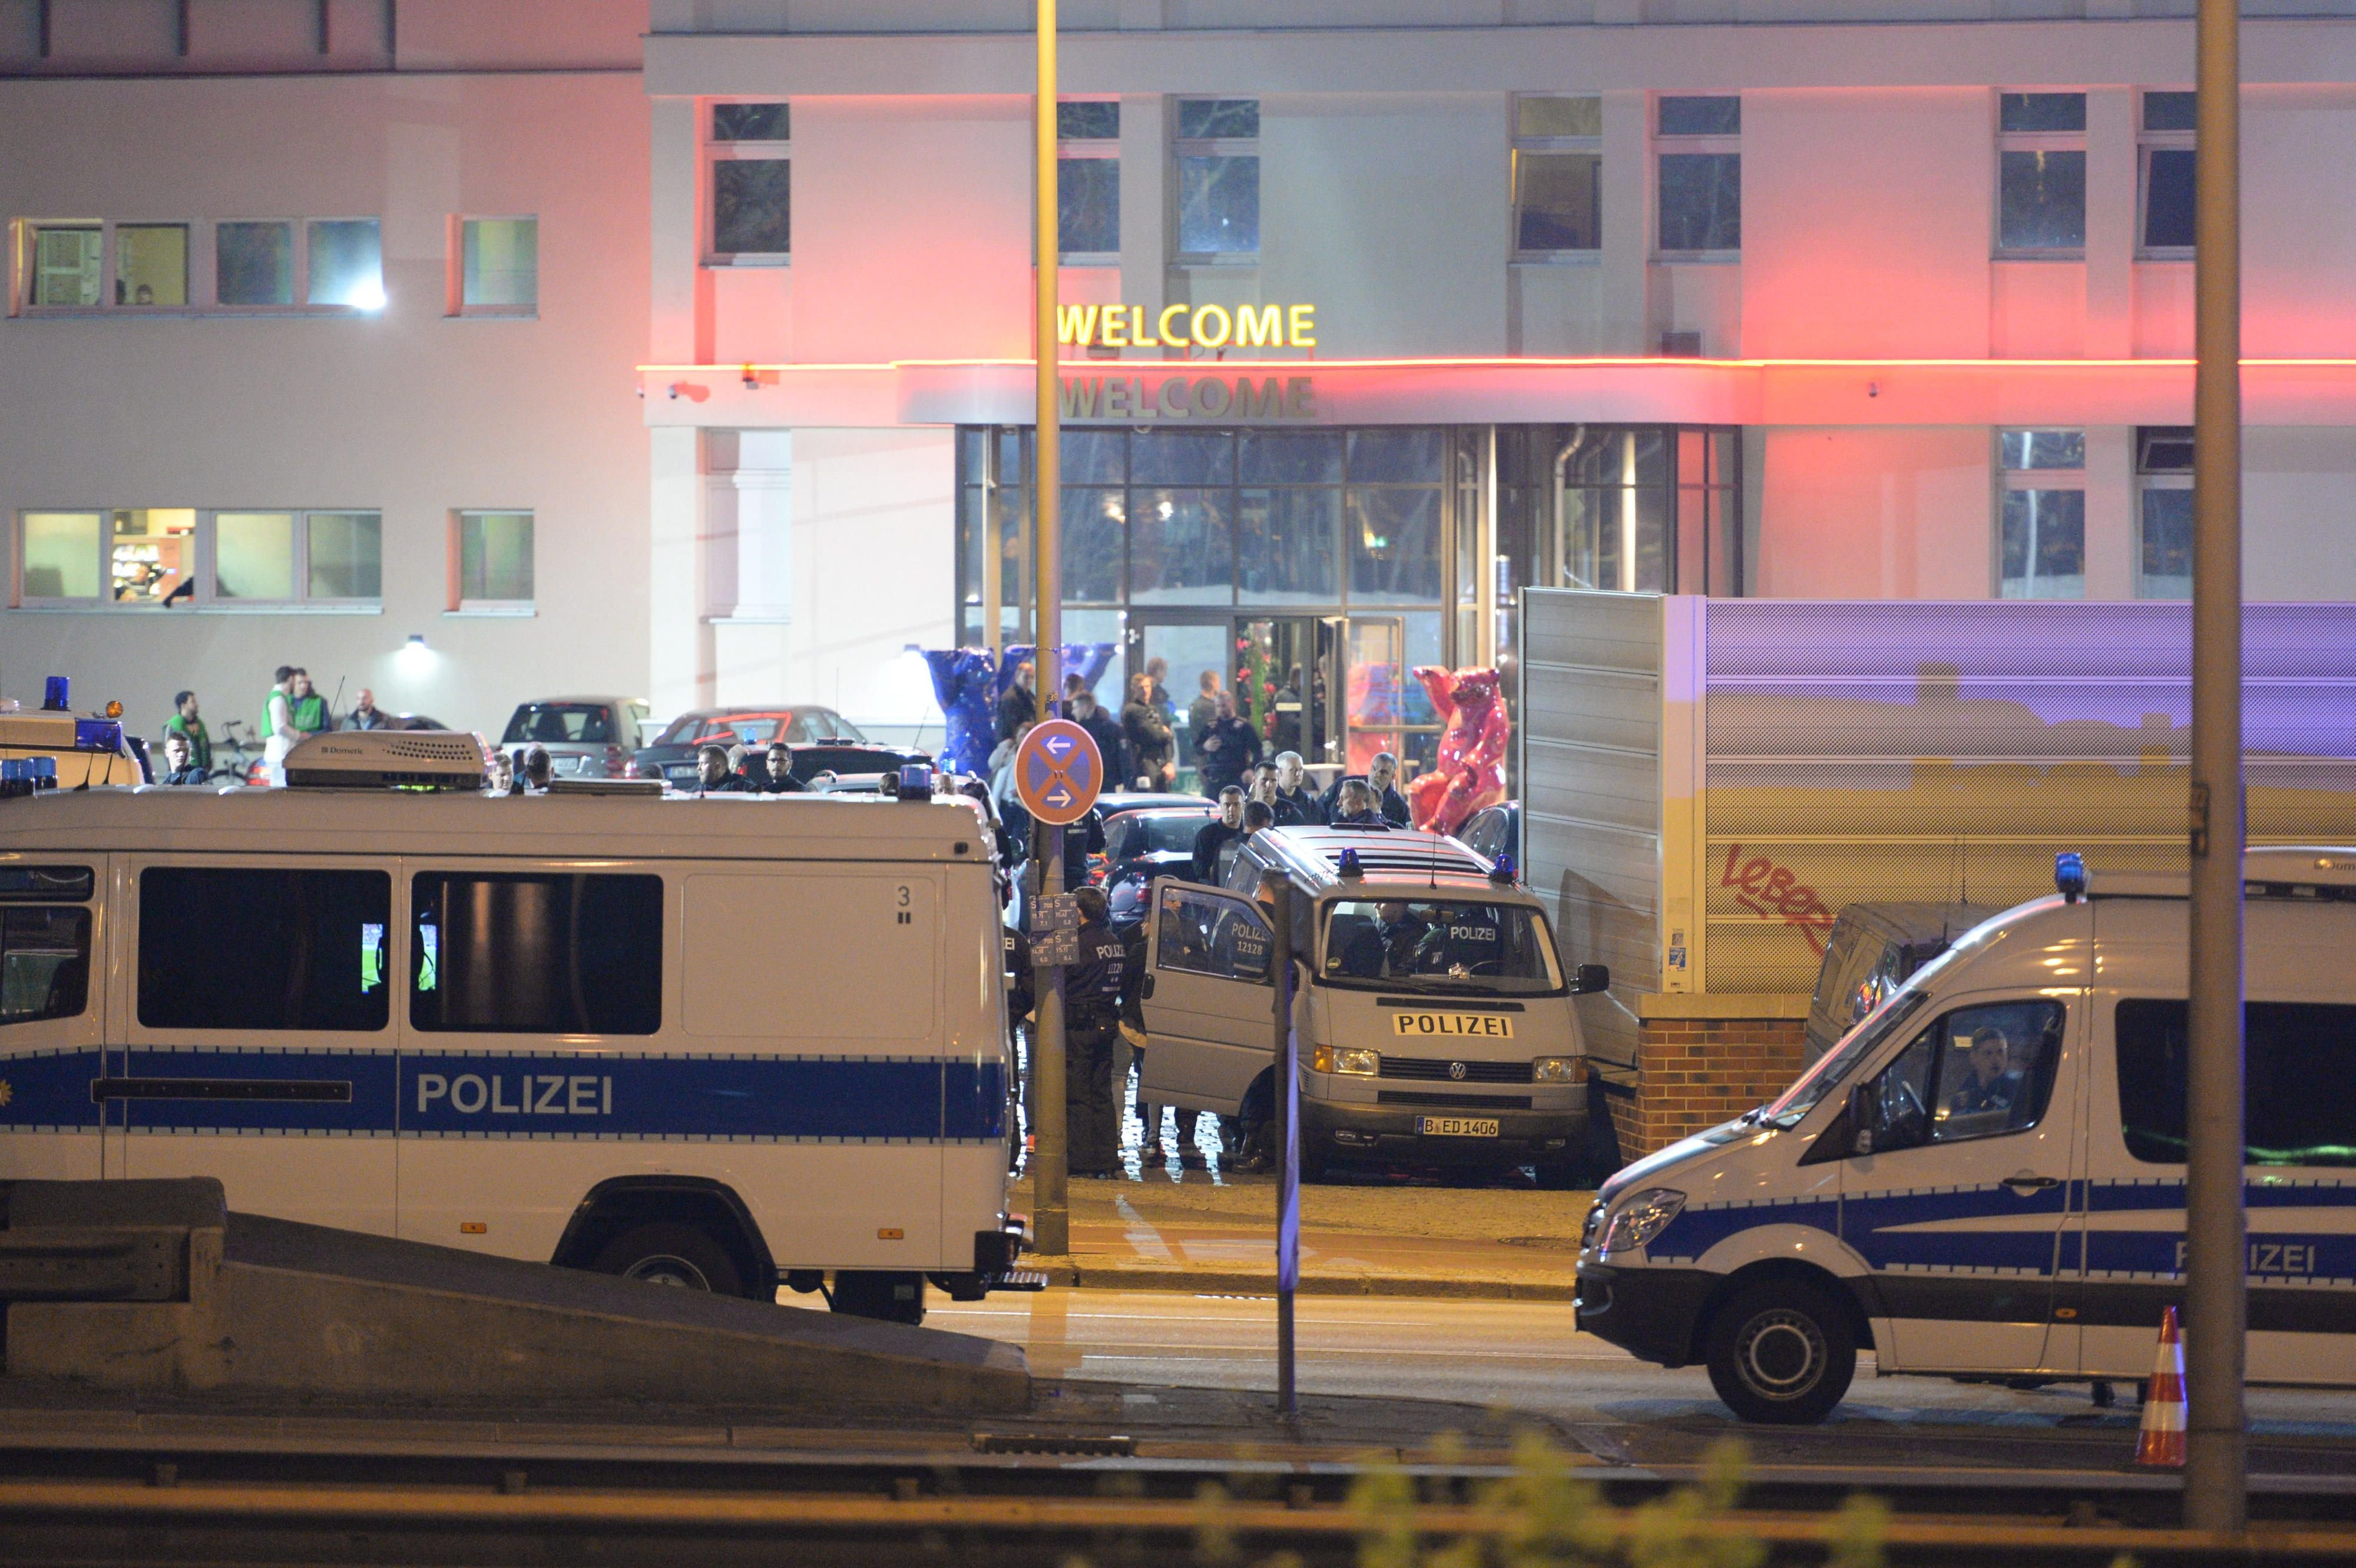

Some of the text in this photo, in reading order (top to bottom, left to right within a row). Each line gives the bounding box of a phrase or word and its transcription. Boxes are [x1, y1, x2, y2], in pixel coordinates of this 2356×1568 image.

[1057, 304, 1316, 348] WELCOME
[1058, 376, 1315, 418] WELCOME
[898, 886, 909, 906] 3
[1451, 927, 1495, 941] POLIZEI
[1237, 941, 1263, 955] 12128
[1398, 1014, 1508, 1037] POLIZEI
[418, 1074, 612, 1114] POLIZEI
[1425, 1120, 1496, 1134] B ED 1406
[2175, 1240, 2315, 1273] PIZEI
